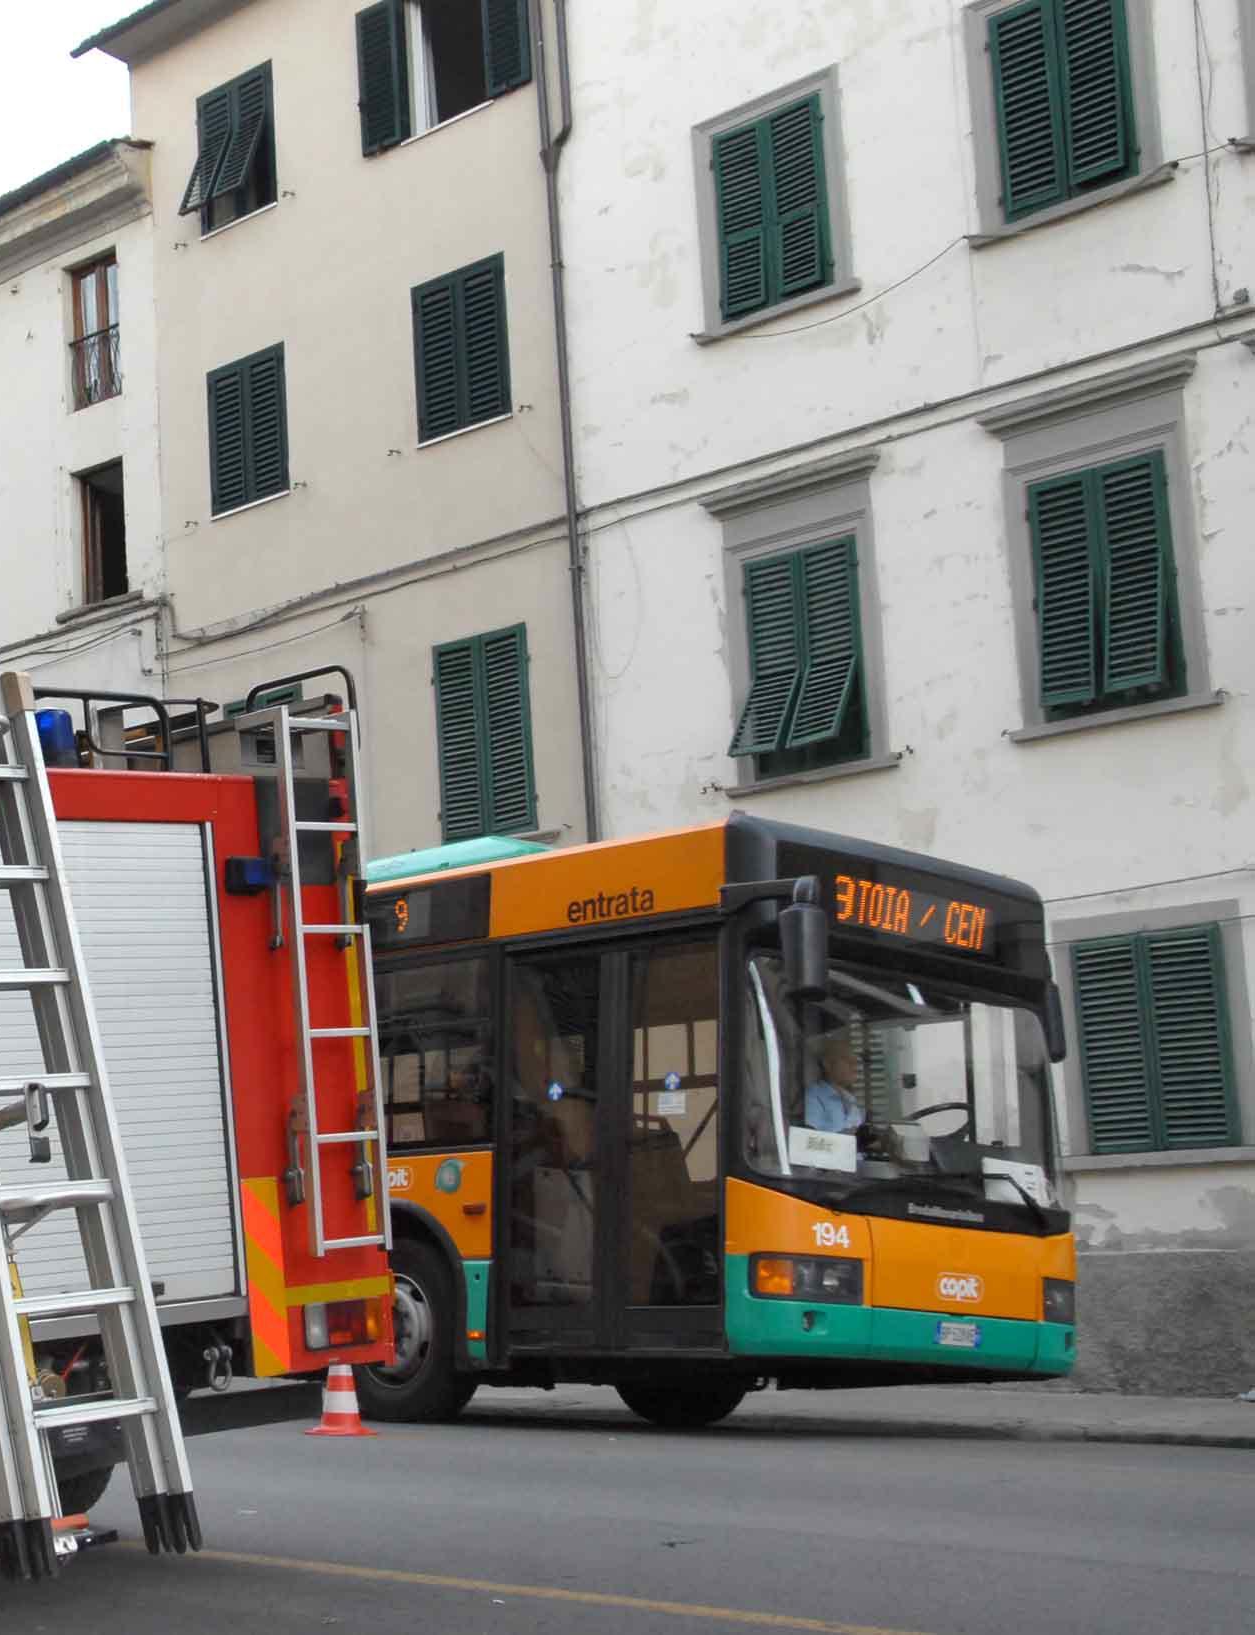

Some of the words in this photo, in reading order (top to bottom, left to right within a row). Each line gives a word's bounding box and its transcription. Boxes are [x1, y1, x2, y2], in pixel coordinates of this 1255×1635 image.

[395, 899, 410, 933] 9
[566, 886, 655, 924] entrata
[945, 901, 986, 950] CEN
[387, 1168, 409, 1188] pit
[811, 1221, 850, 1249] 194
